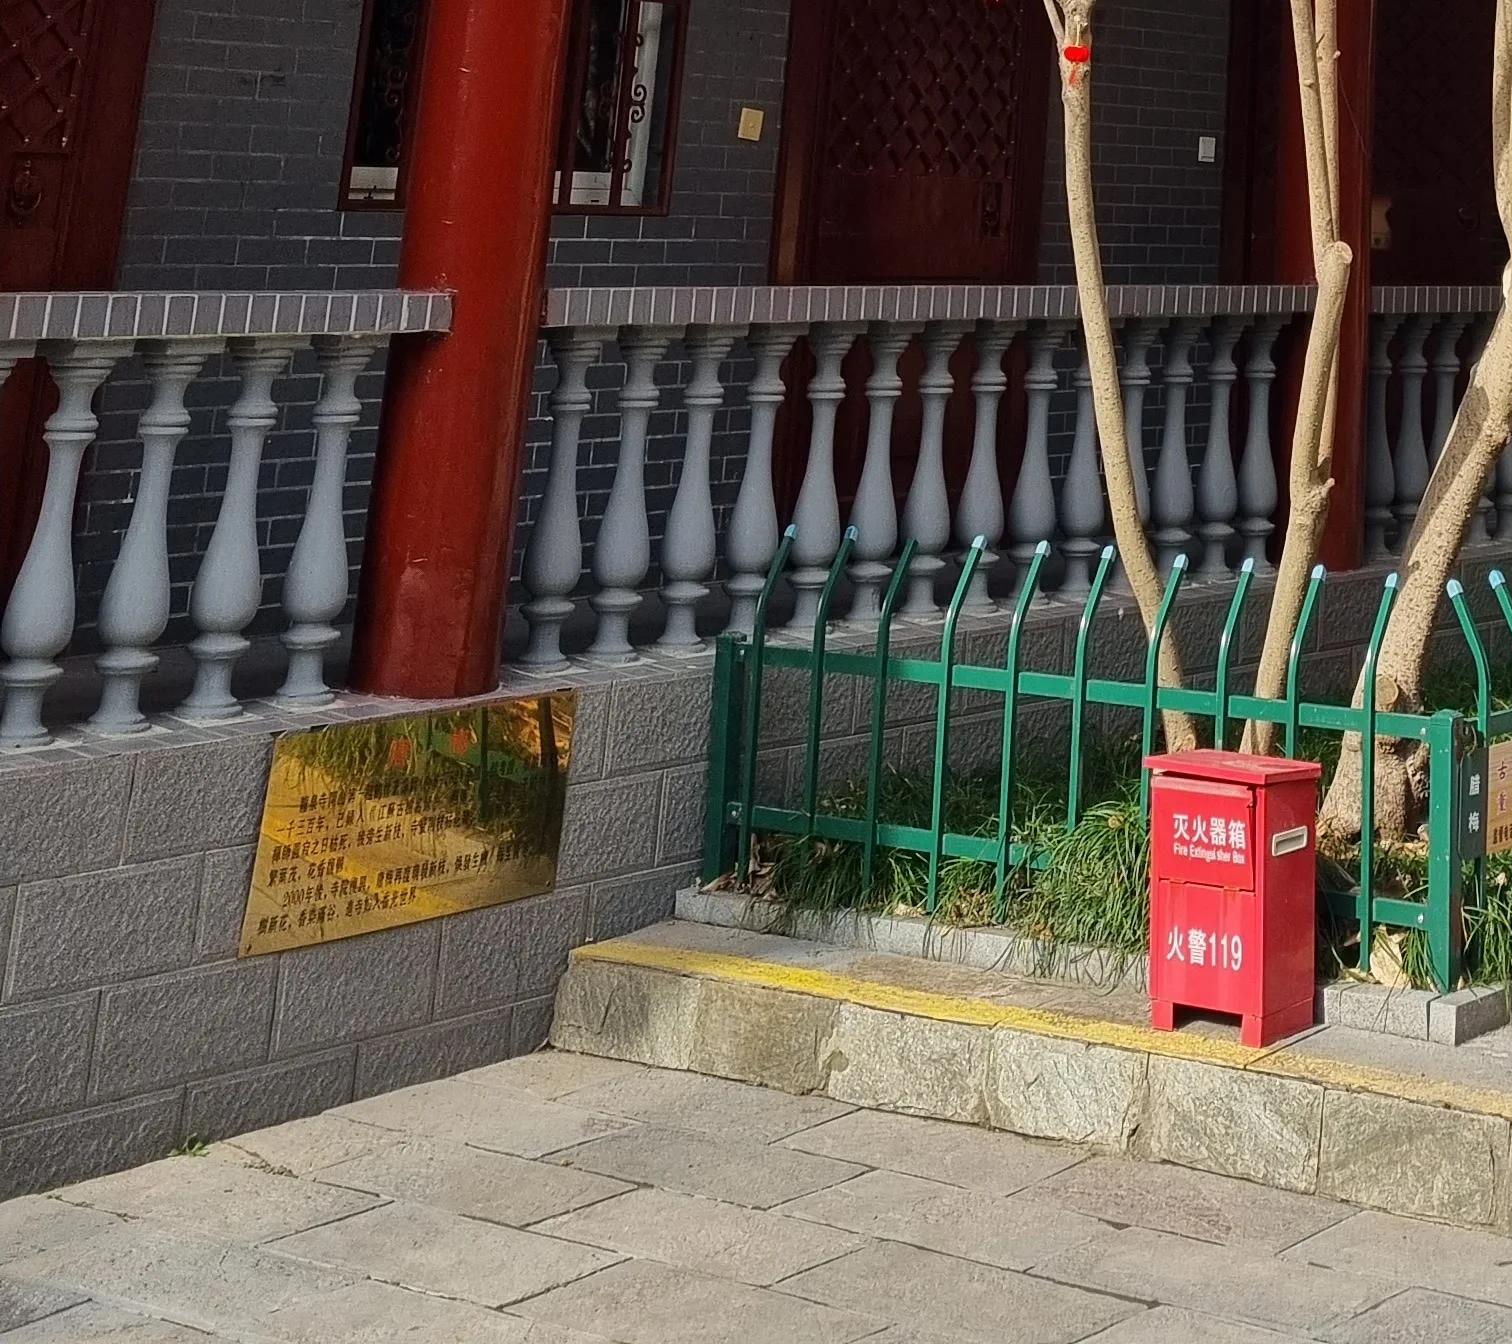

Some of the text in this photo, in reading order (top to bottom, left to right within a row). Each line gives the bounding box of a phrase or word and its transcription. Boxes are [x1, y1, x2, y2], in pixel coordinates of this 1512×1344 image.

[1172, 813, 1247, 850] 灭火器箱
[1173, 842, 1188, 857] Fire
[1232, 850, 1246, 865] Box
[1166, 925, 1243, 972] 火警119
